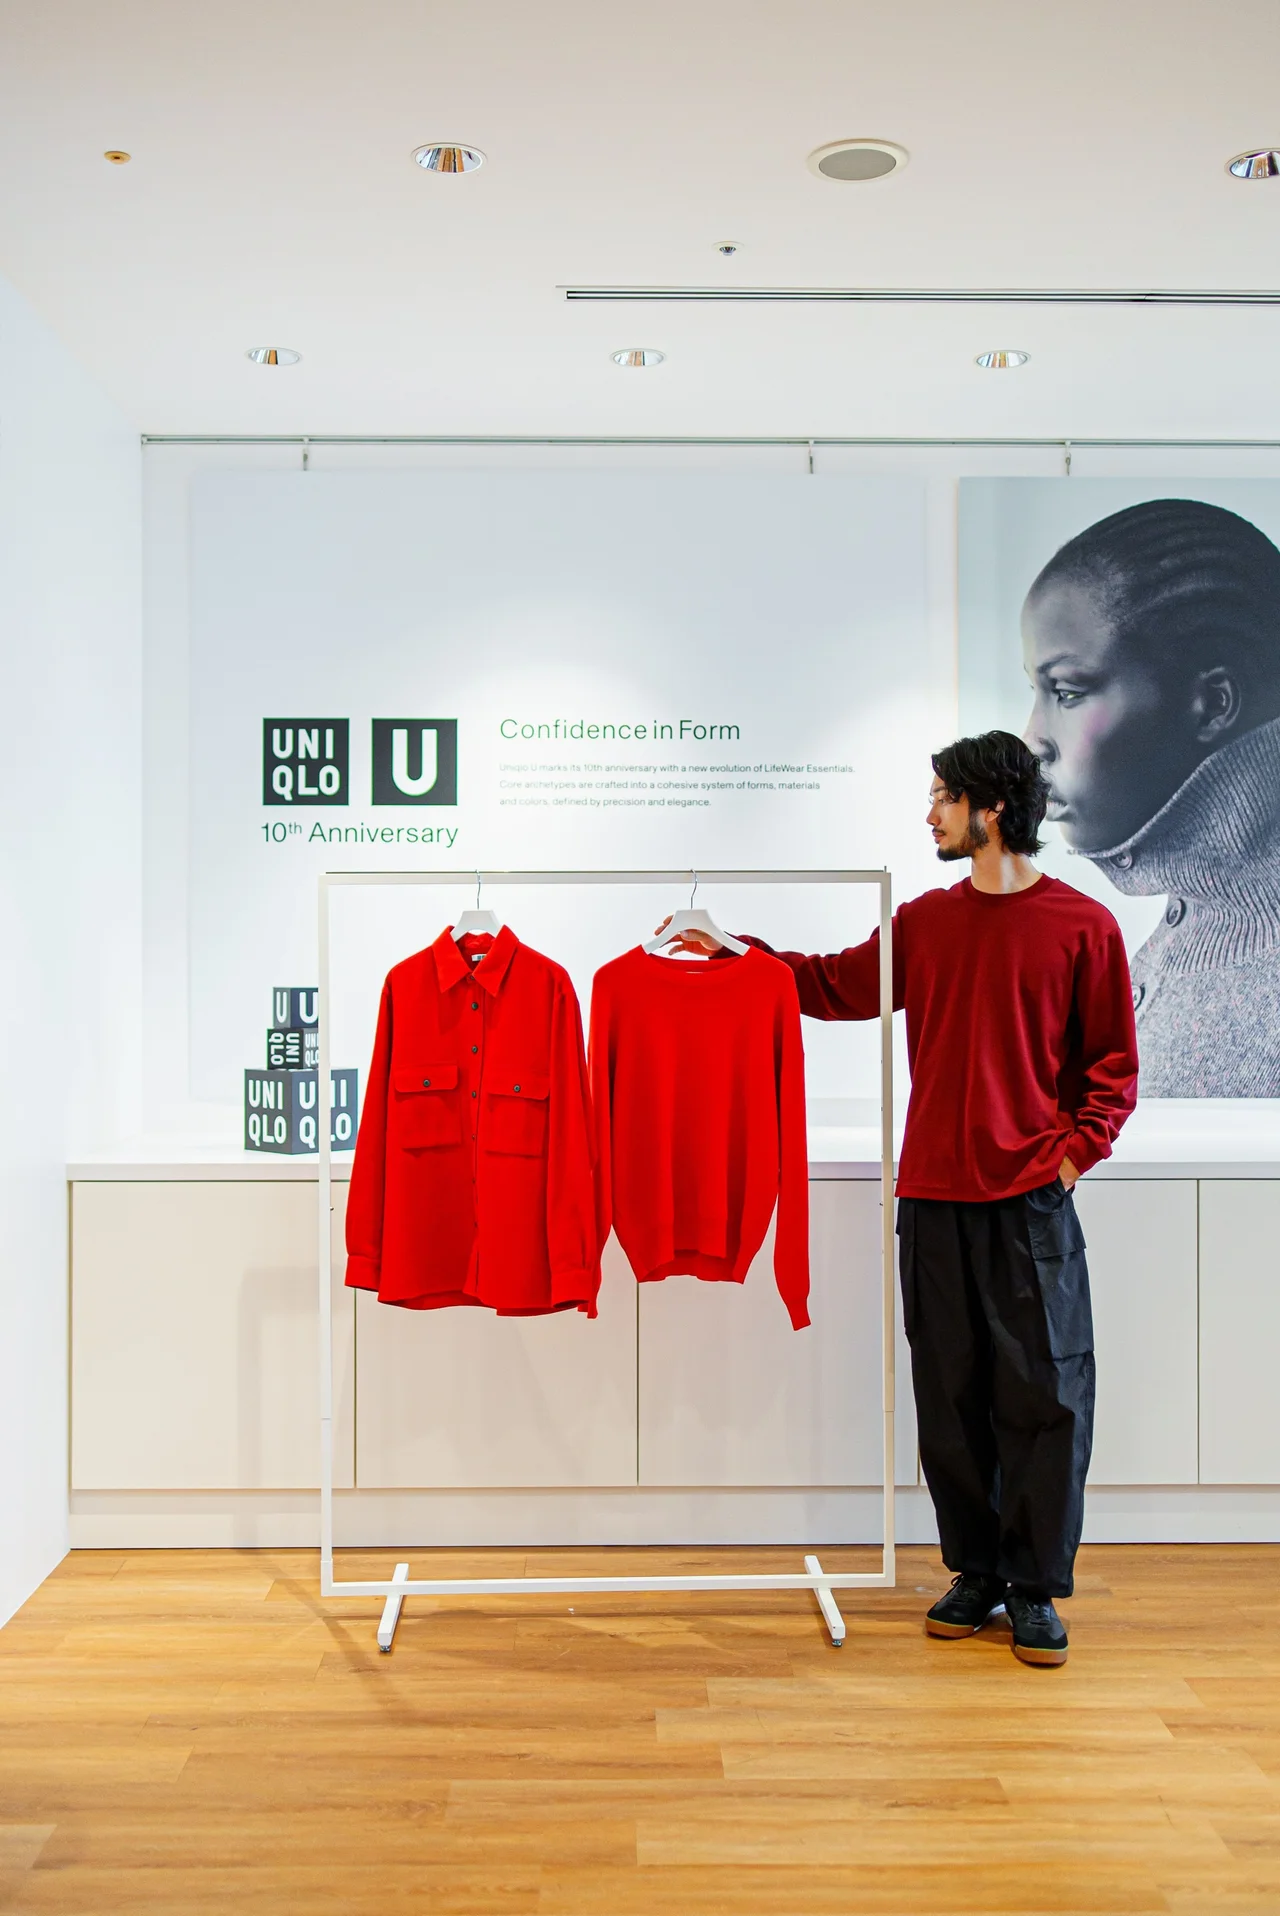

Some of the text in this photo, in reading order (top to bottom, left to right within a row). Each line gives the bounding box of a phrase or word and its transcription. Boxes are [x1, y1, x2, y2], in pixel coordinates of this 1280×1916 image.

[272, 728, 334, 759] UNI
[500, 719, 740, 739] Confidence in Form
[392, 728, 438, 796] U
[530, 763, 538, 772] U
[539, 763, 568, 772] marks
[570, 763, 581, 772] its
[584, 763, 602, 772] 10th
[604, 764, 657, 774] anniversary
[659, 764, 679, 772] with
[688, 765, 708, 773] new
[709, 764, 751, 773] evolution
[753, 764, 763, 773] of
[764, 764, 805, 773] LifeWear
[806, 764, 856, 773] Essentials.
[272, 765, 340, 801] QLO
[499, 780, 522, 789] Core
[524, 780, 576, 790] archetypes
[595, 780, 628, 789] crafted
[630, 780, 648, 789] into
[657, 781, 699, 789] cohesive
[700, 782, 734, 791] system
[736, 781, 746, 789] of
[747, 781, 777, 791] forms,
[778, 781, 821, 790] materials
[499, 797, 517, 805] and
[552, 797, 588, 806] defined
[589, 797, 601, 808] by
[603, 797, 646, 807] precision
[647, 797, 665, 806] and
[667, 797, 712, 808] elegance.
[261, 821, 459, 848] 10th Anniversary
[276, 991, 287, 1023] U
[299, 991, 319, 1024] U
[268, 1032, 285, 1066] QLO
[285, 1032, 300, 1063] UNI
[248, 1079, 284, 1111] UNI
[299, 1079, 347, 1110] UI
[248, 1113, 287, 1147] QLO
[299, 1112, 352, 1149] QO
